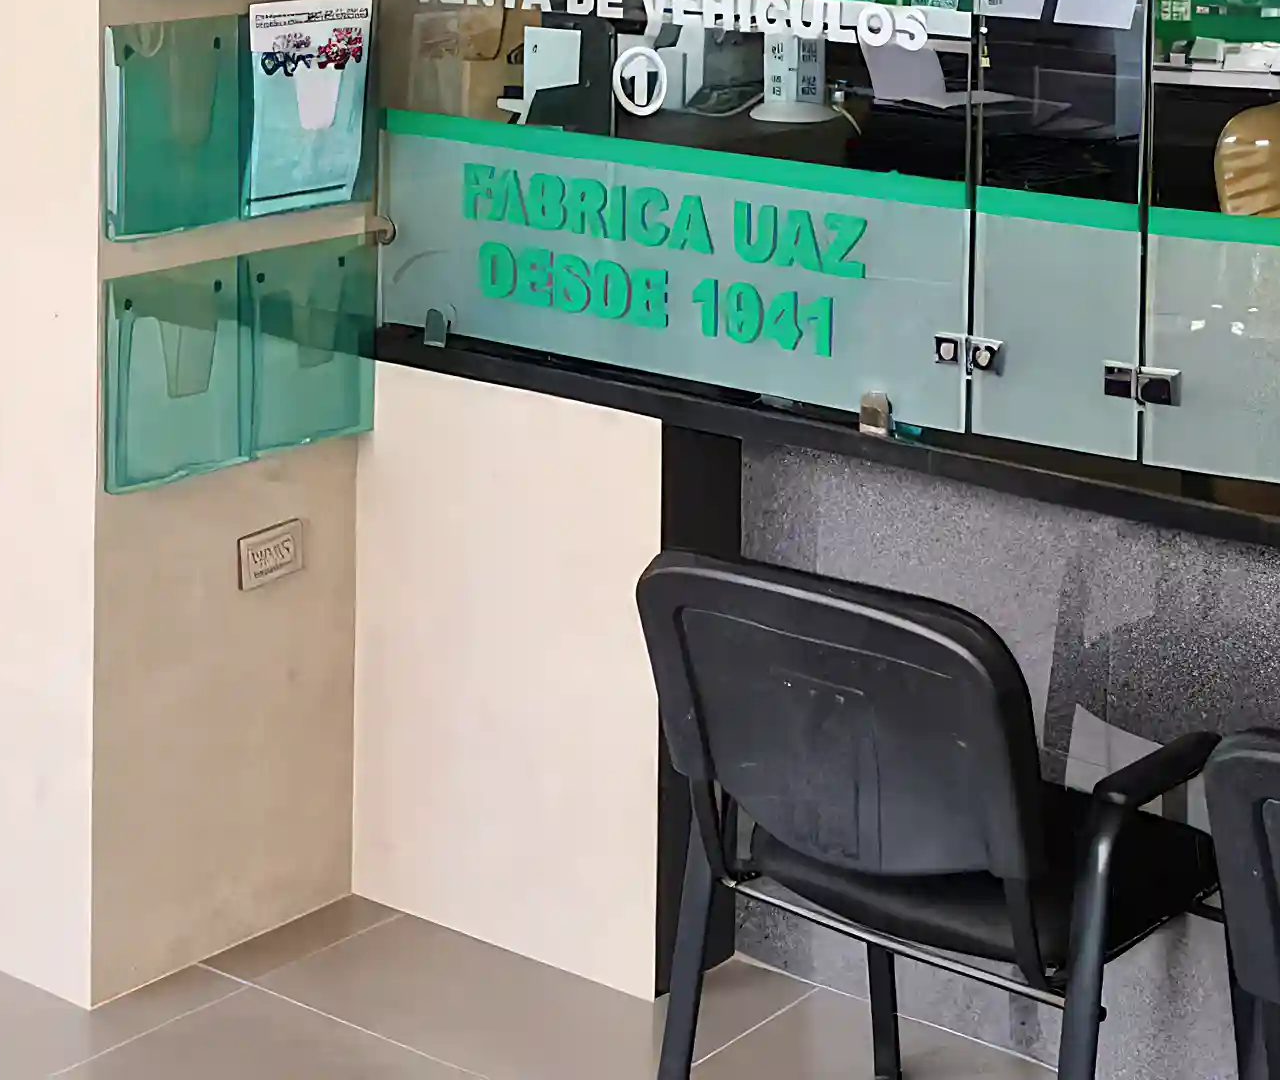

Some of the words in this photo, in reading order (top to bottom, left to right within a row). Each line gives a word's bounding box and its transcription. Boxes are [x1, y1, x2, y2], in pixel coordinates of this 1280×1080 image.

[463, 162, 714, 256] FABRICA
[733, 200, 869, 279] UAZ
[477, 241, 670, 329] DESDE
[692, 277, 834, 358] 1941
